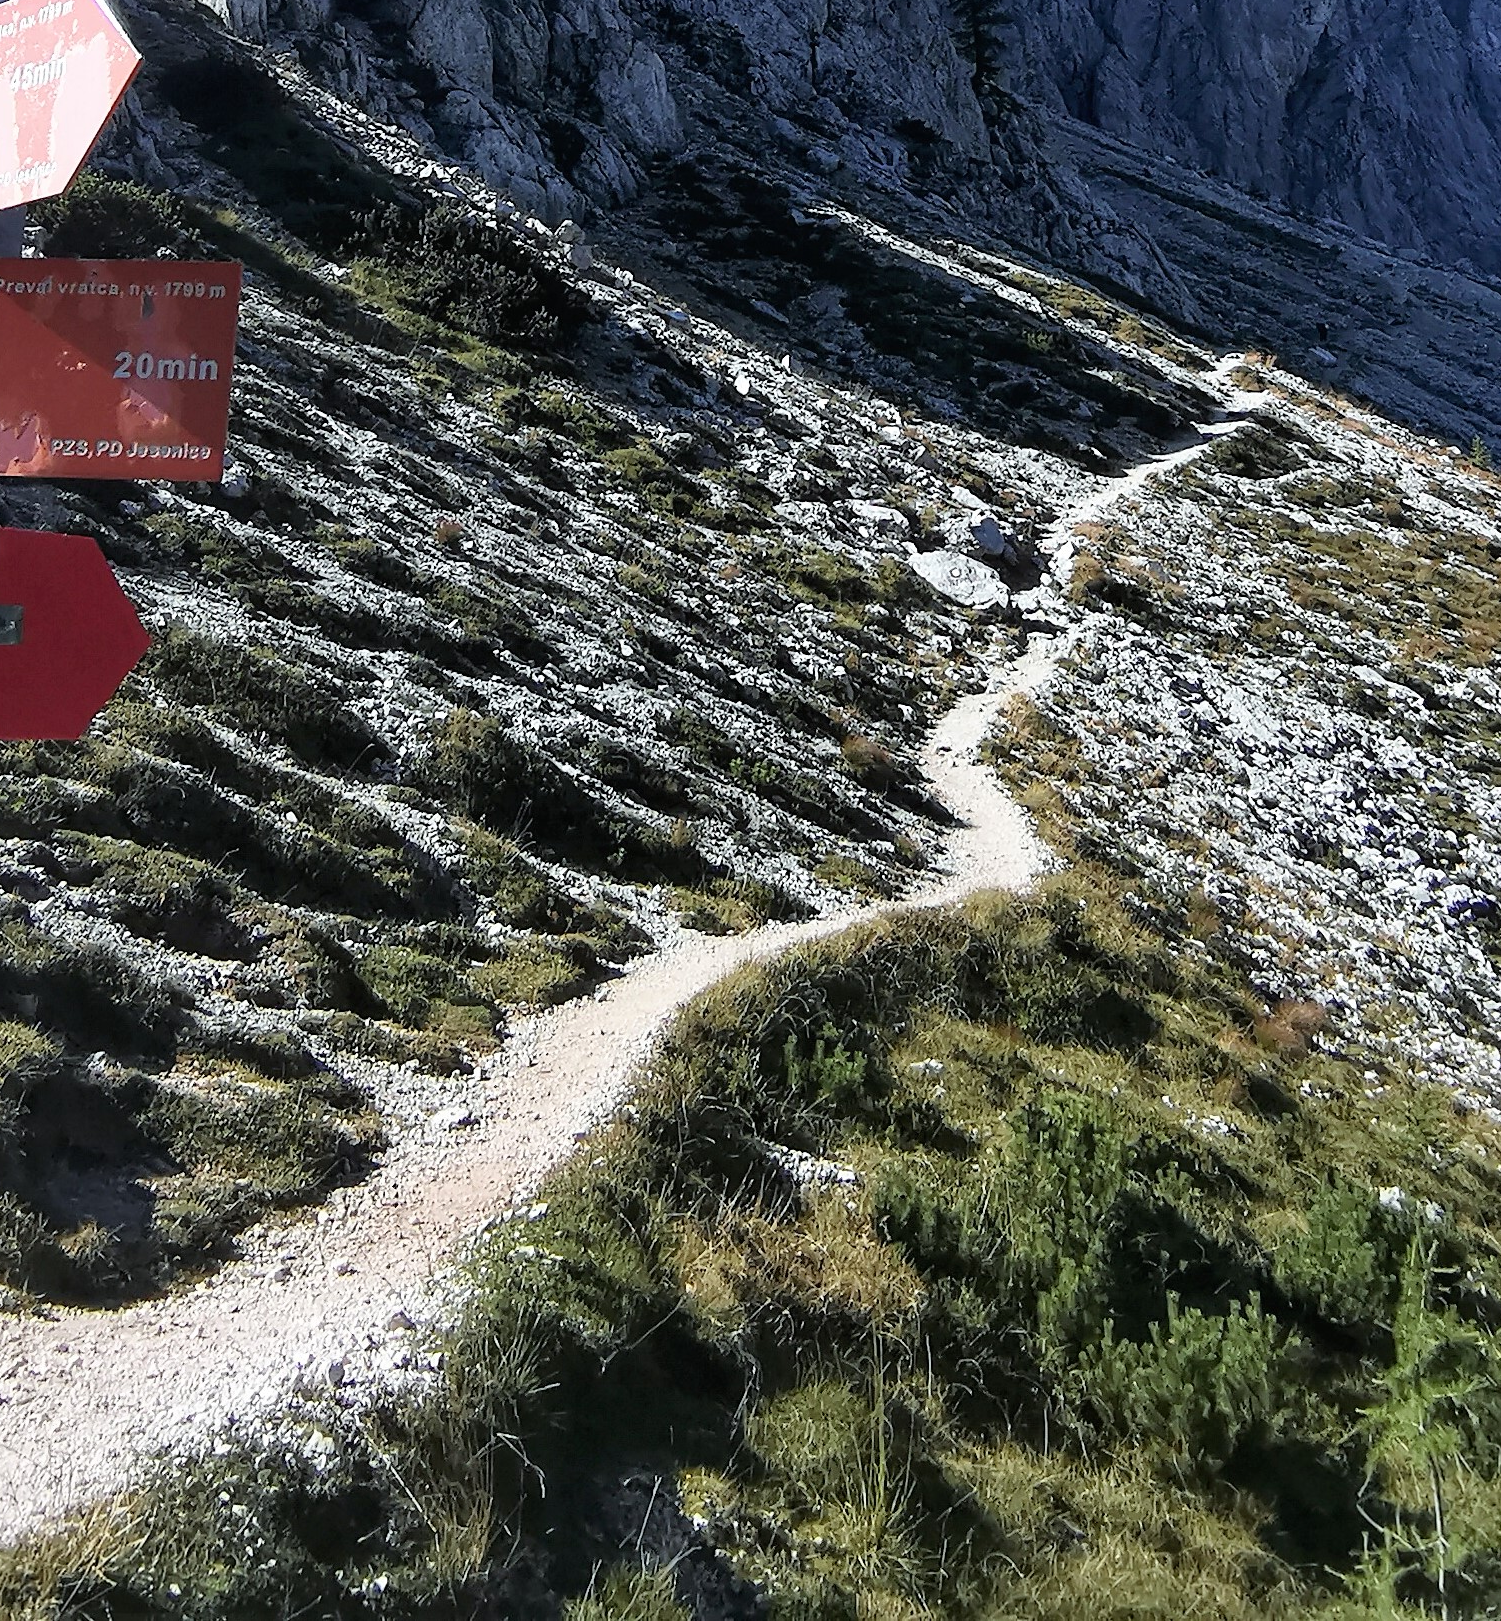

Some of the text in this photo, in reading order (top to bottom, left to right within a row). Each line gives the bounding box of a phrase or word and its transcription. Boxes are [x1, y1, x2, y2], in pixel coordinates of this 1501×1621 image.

[10, 56, 67, 93] 45min
[58, 279, 124, 298] vratca,
[208, 283, 227, 299] m
[113, 351, 219, 381] 20min
[51, 438, 93, 459] PZS,
[96, 440, 124, 458] PD
